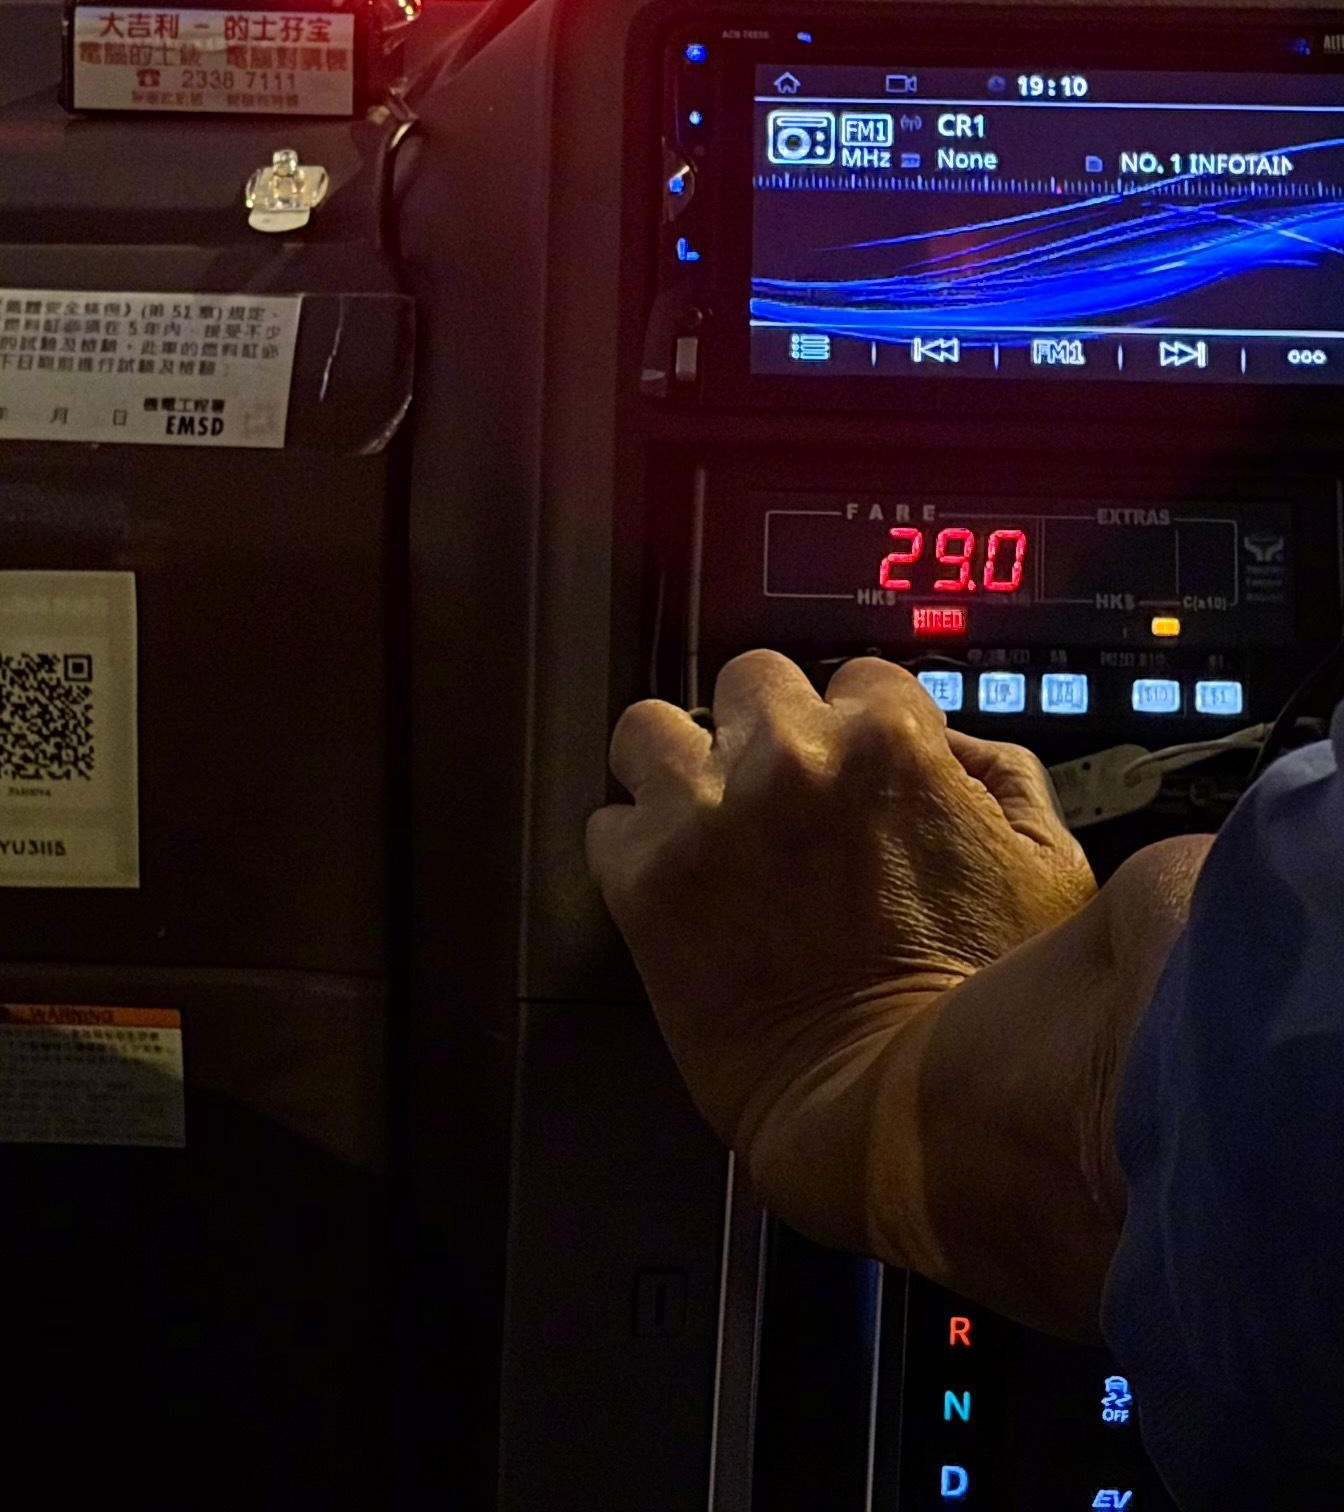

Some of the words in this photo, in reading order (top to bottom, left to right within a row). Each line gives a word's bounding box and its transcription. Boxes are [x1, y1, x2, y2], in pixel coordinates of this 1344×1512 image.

[99, 11, 179, 39] 大吉利
[181, 70, 234, 89] 2338
[245, 72, 295, 90] 7111
[1017, 75, 1088, 97] 19:10
[846, 120, 886, 142] FM1
[937, 114, 986, 137] CR1
[842, 148, 891, 168] MHz
[937, 148, 998, 169] None
[1121, 152, 1164, 174] NO.
[1170, 153, 1181, 174] 1
[1033, 339, 1085, 364] FM1
[166, 415, 225, 436] EMSD
[846, 503, 936, 522] FARE
[1096, 508, 1171, 526] EXTRAS
[879, 527, 1027, 592] 29.0
[949, 1315, 972, 1347] R
[943, 1390, 971, 1423] N
[1102, 1409, 1130, 1424] OFF
[940, 1465, 970, 1497] D
[1092, 1489, 1133, 1509] EV
